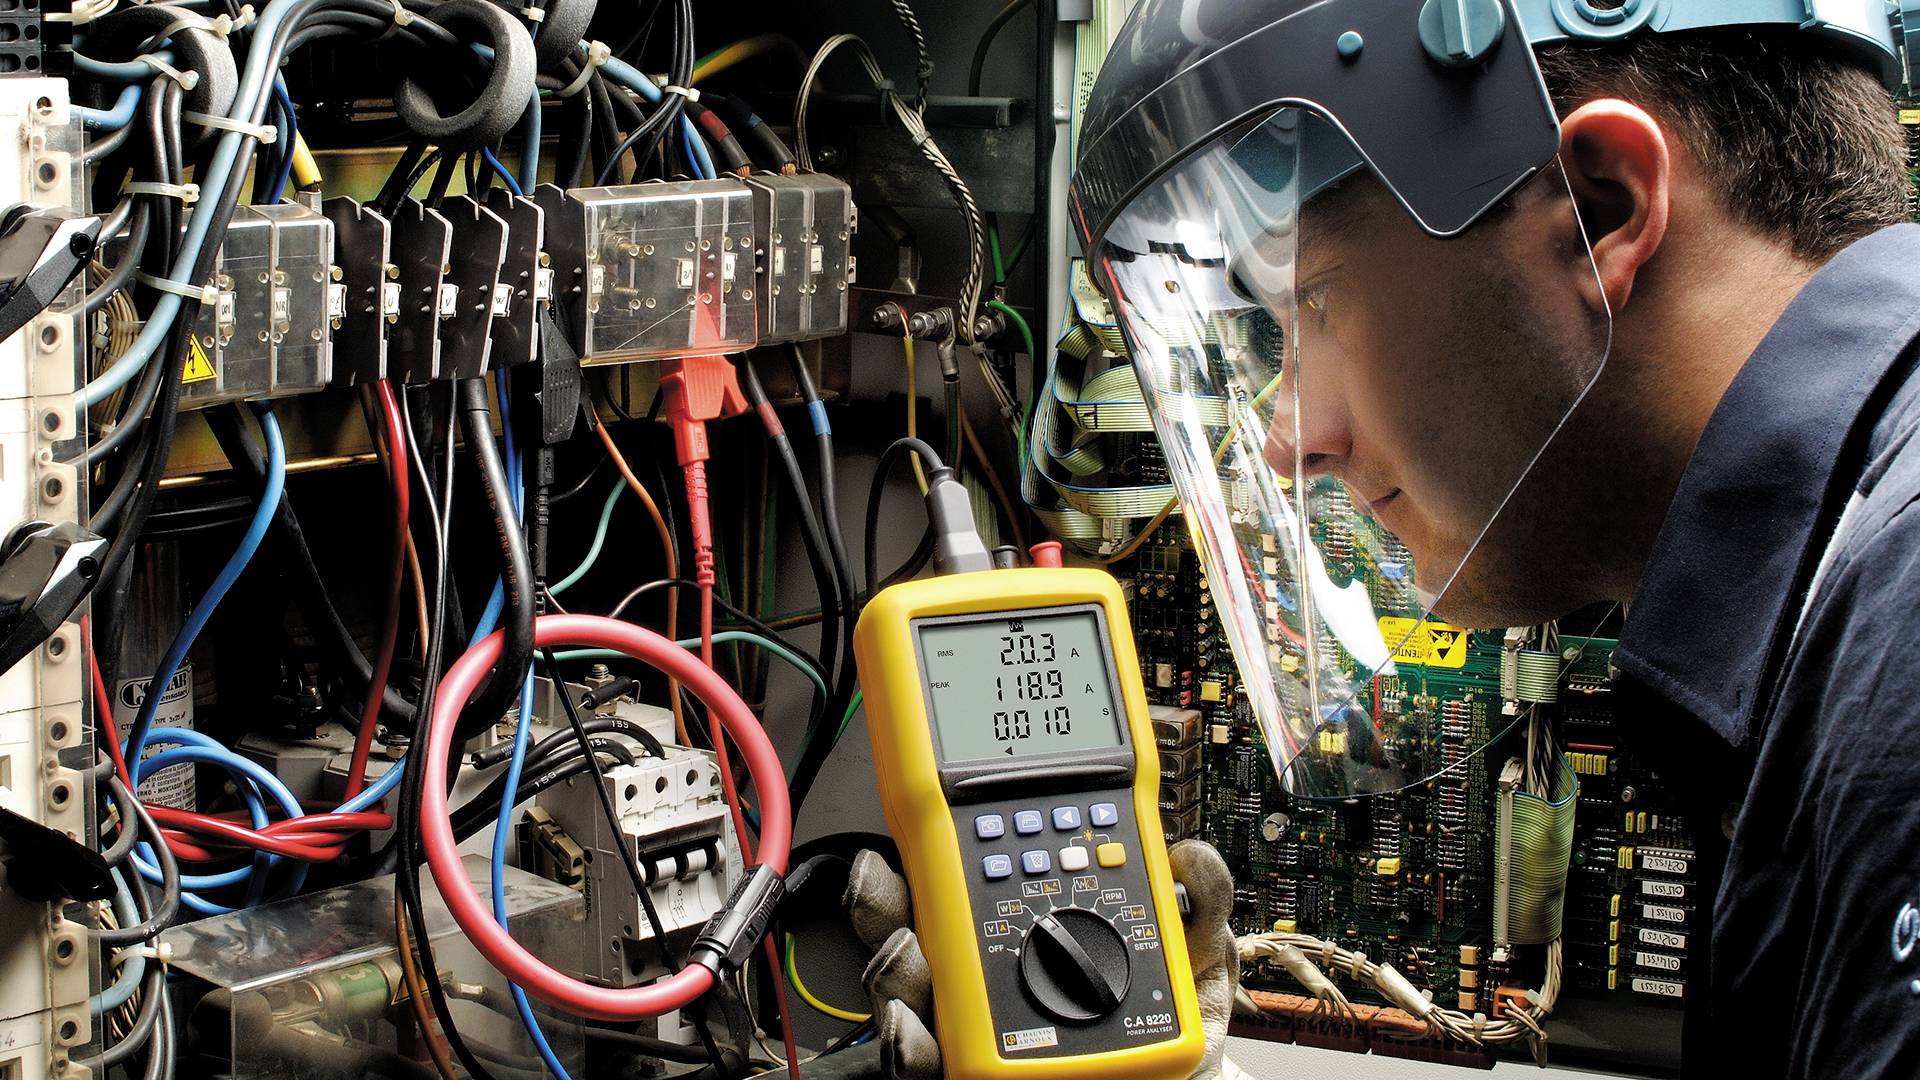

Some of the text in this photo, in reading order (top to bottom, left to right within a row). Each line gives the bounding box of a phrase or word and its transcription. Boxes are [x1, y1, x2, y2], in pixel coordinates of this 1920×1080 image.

[937, 650, 954, 658] RMS
[1070, 648, 1080, 658] A
[930, 681, 951, 689] PEAK
[1084, 683, 1094, 694] A
[993, 706, 1071, 741] 0.010
[1105, 892, 1122, 900] RPM
[988, 944, 1004, 953] OFF
[1134, 941, 1159, 951] SETUP
[1147, 1013, 1172, 1026] 8220
[1126, 1025, 1173, 1037] POWER ANALYSER
